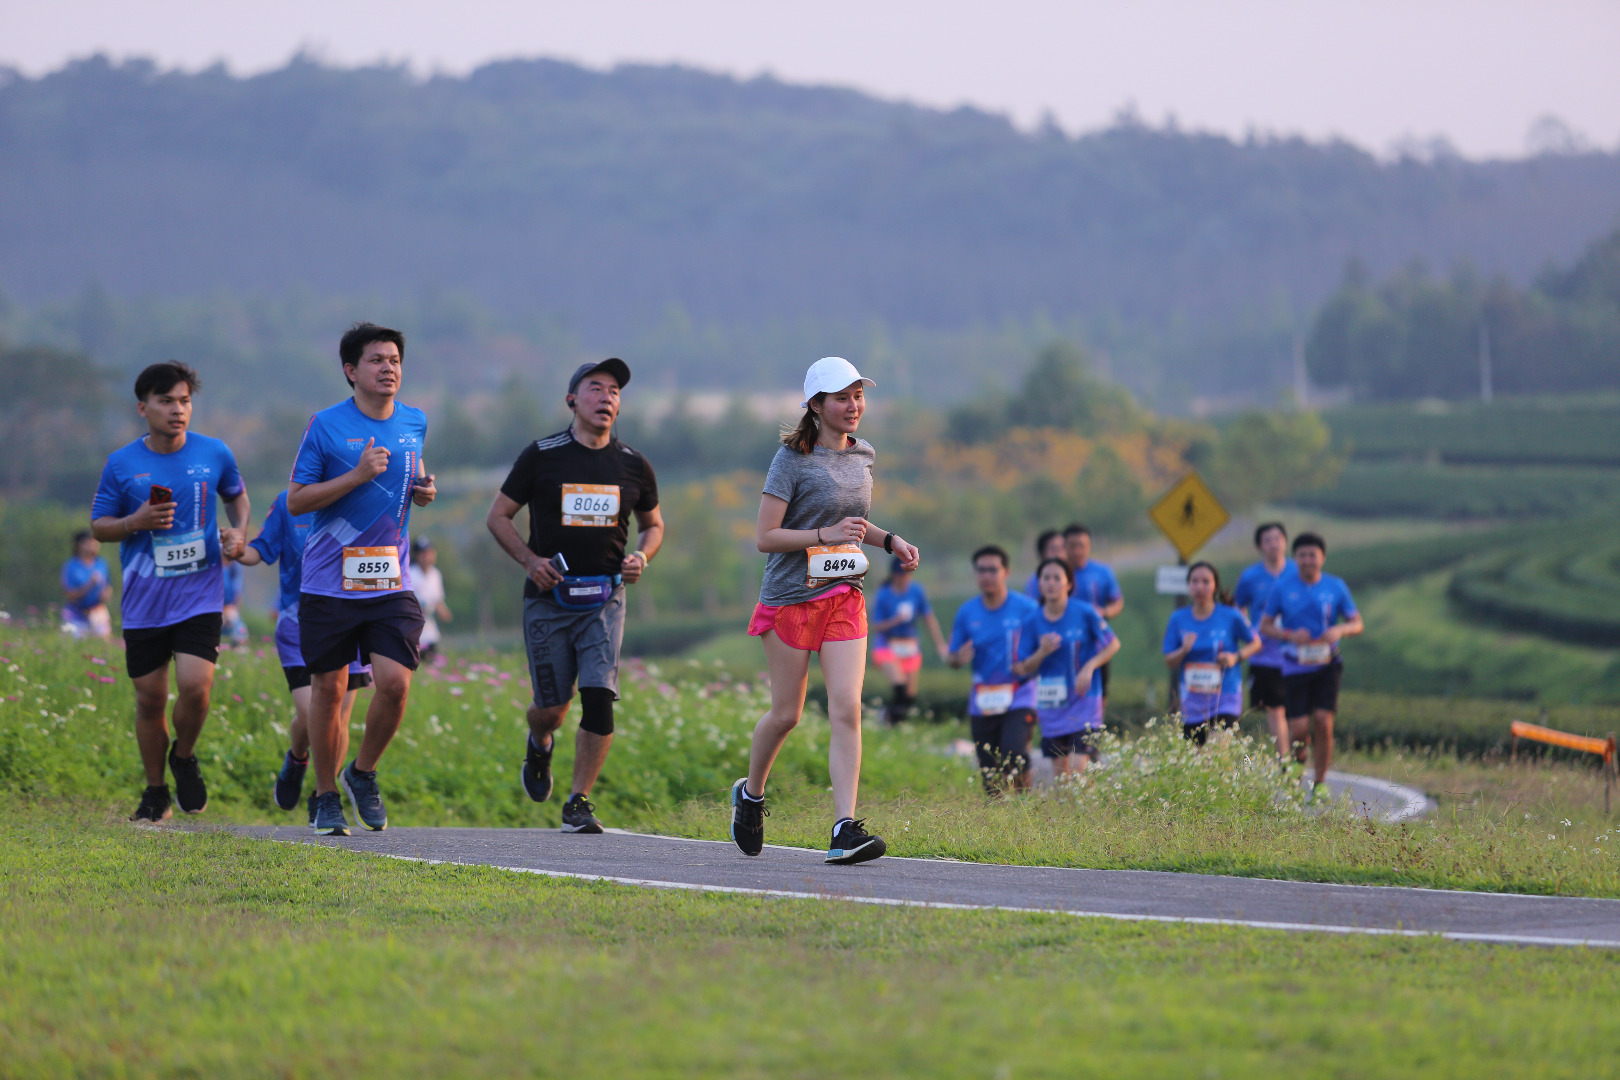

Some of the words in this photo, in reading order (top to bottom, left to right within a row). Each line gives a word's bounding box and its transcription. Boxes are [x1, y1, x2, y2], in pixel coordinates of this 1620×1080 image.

[400, 473, 410, 504] COUNTRY
[573, 497, 610, 512] 8066
[167, 546, 196, 561] 5155
[357, 561, 390, 574] 8559
[823, 558, 856, 572] 8494
